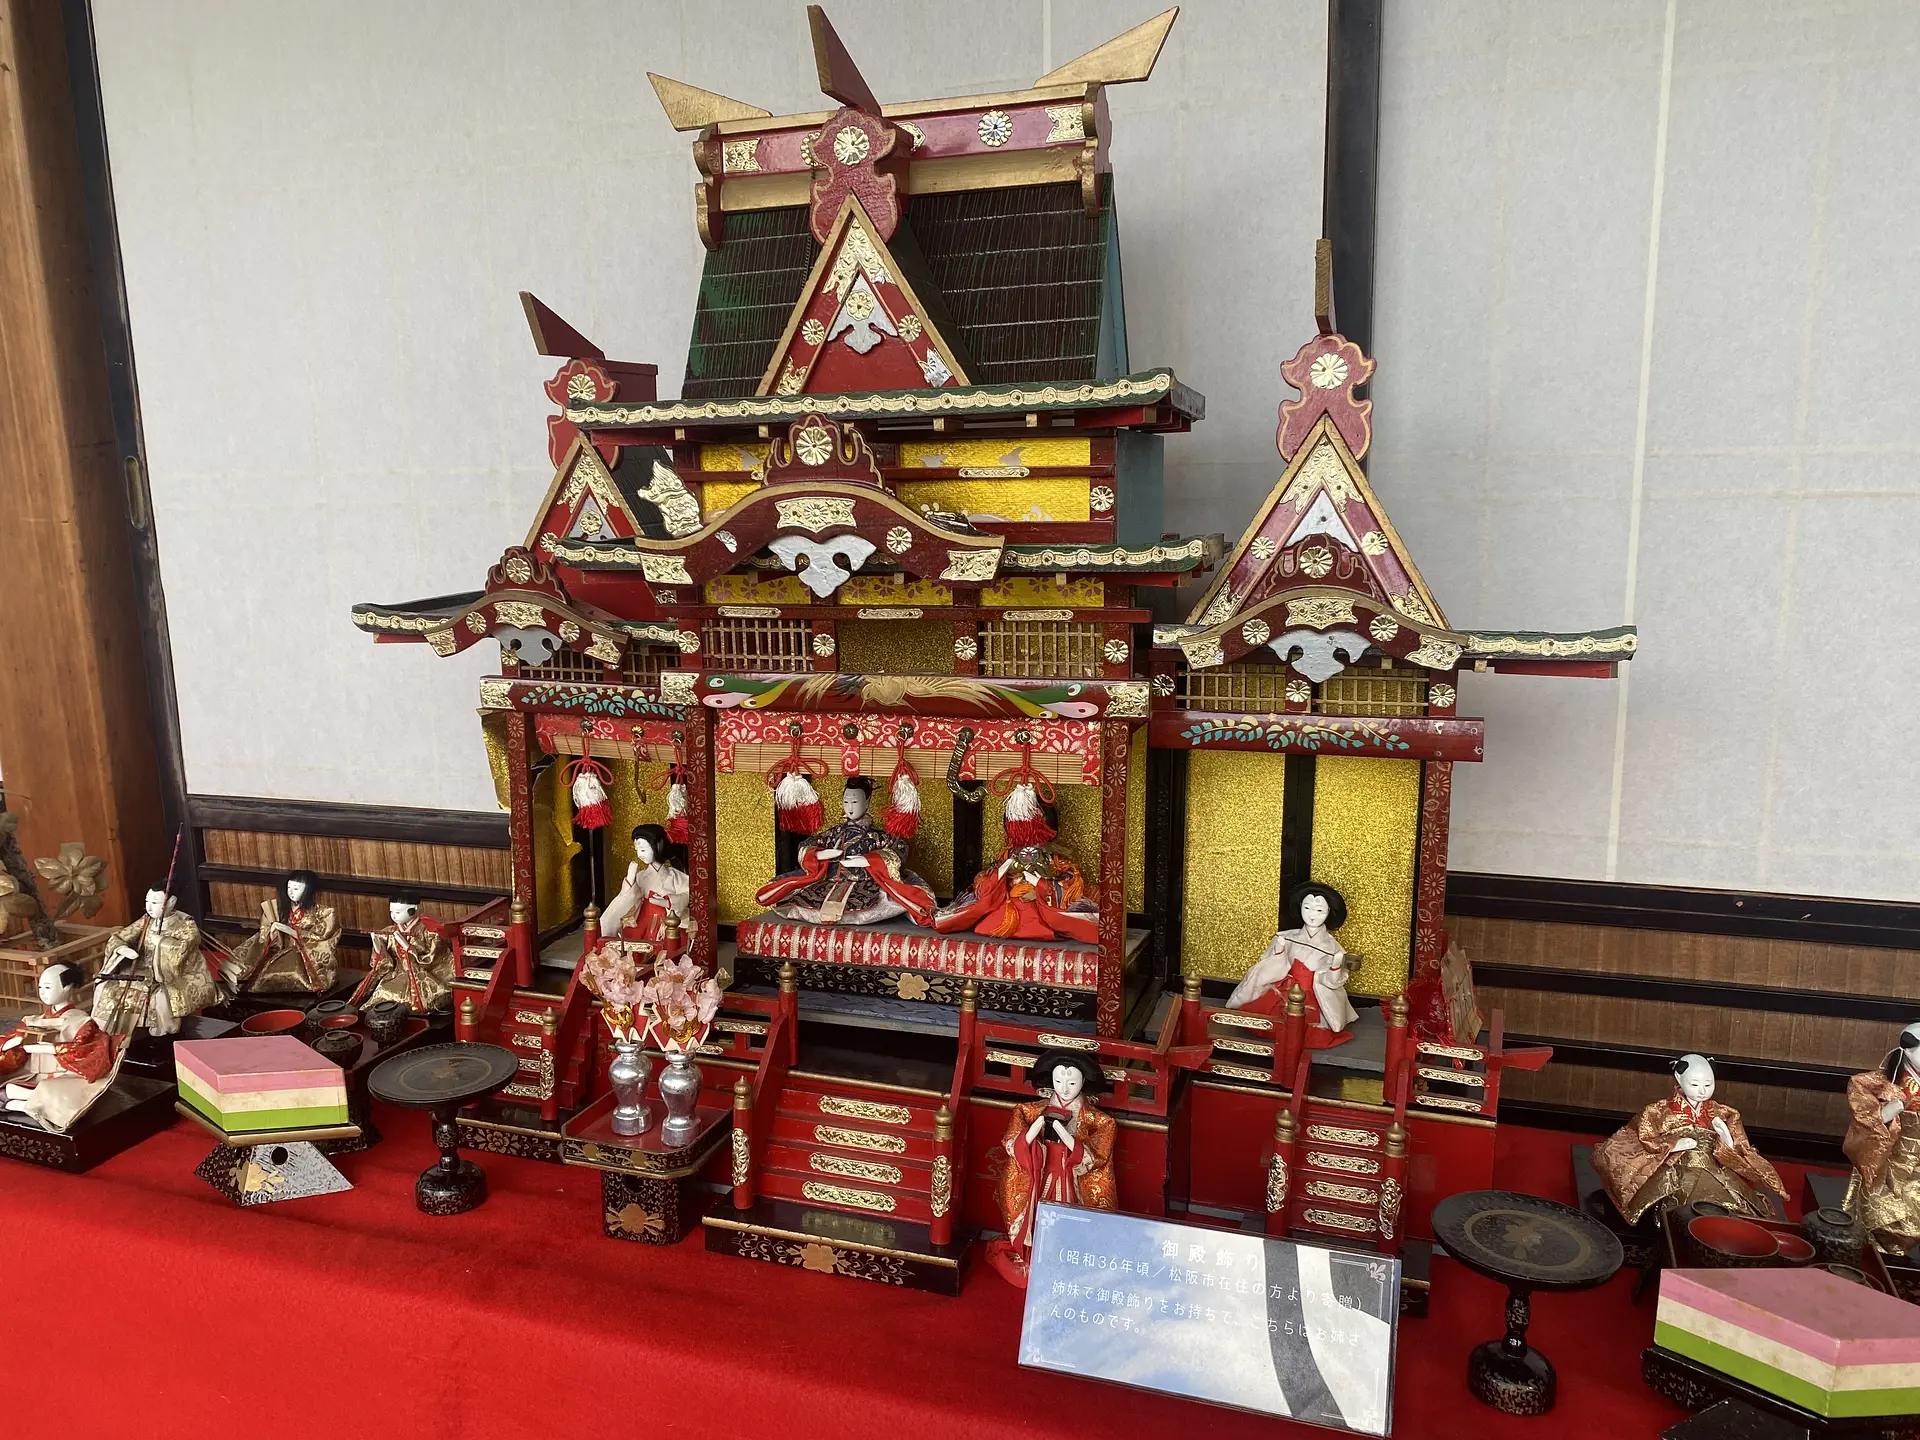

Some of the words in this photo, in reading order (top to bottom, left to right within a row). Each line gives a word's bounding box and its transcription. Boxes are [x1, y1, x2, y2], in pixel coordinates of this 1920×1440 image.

[1161, 1239, 1259, 1271] 御殿飾り
[1049, 1305, 1141, 1333] んのものです。
